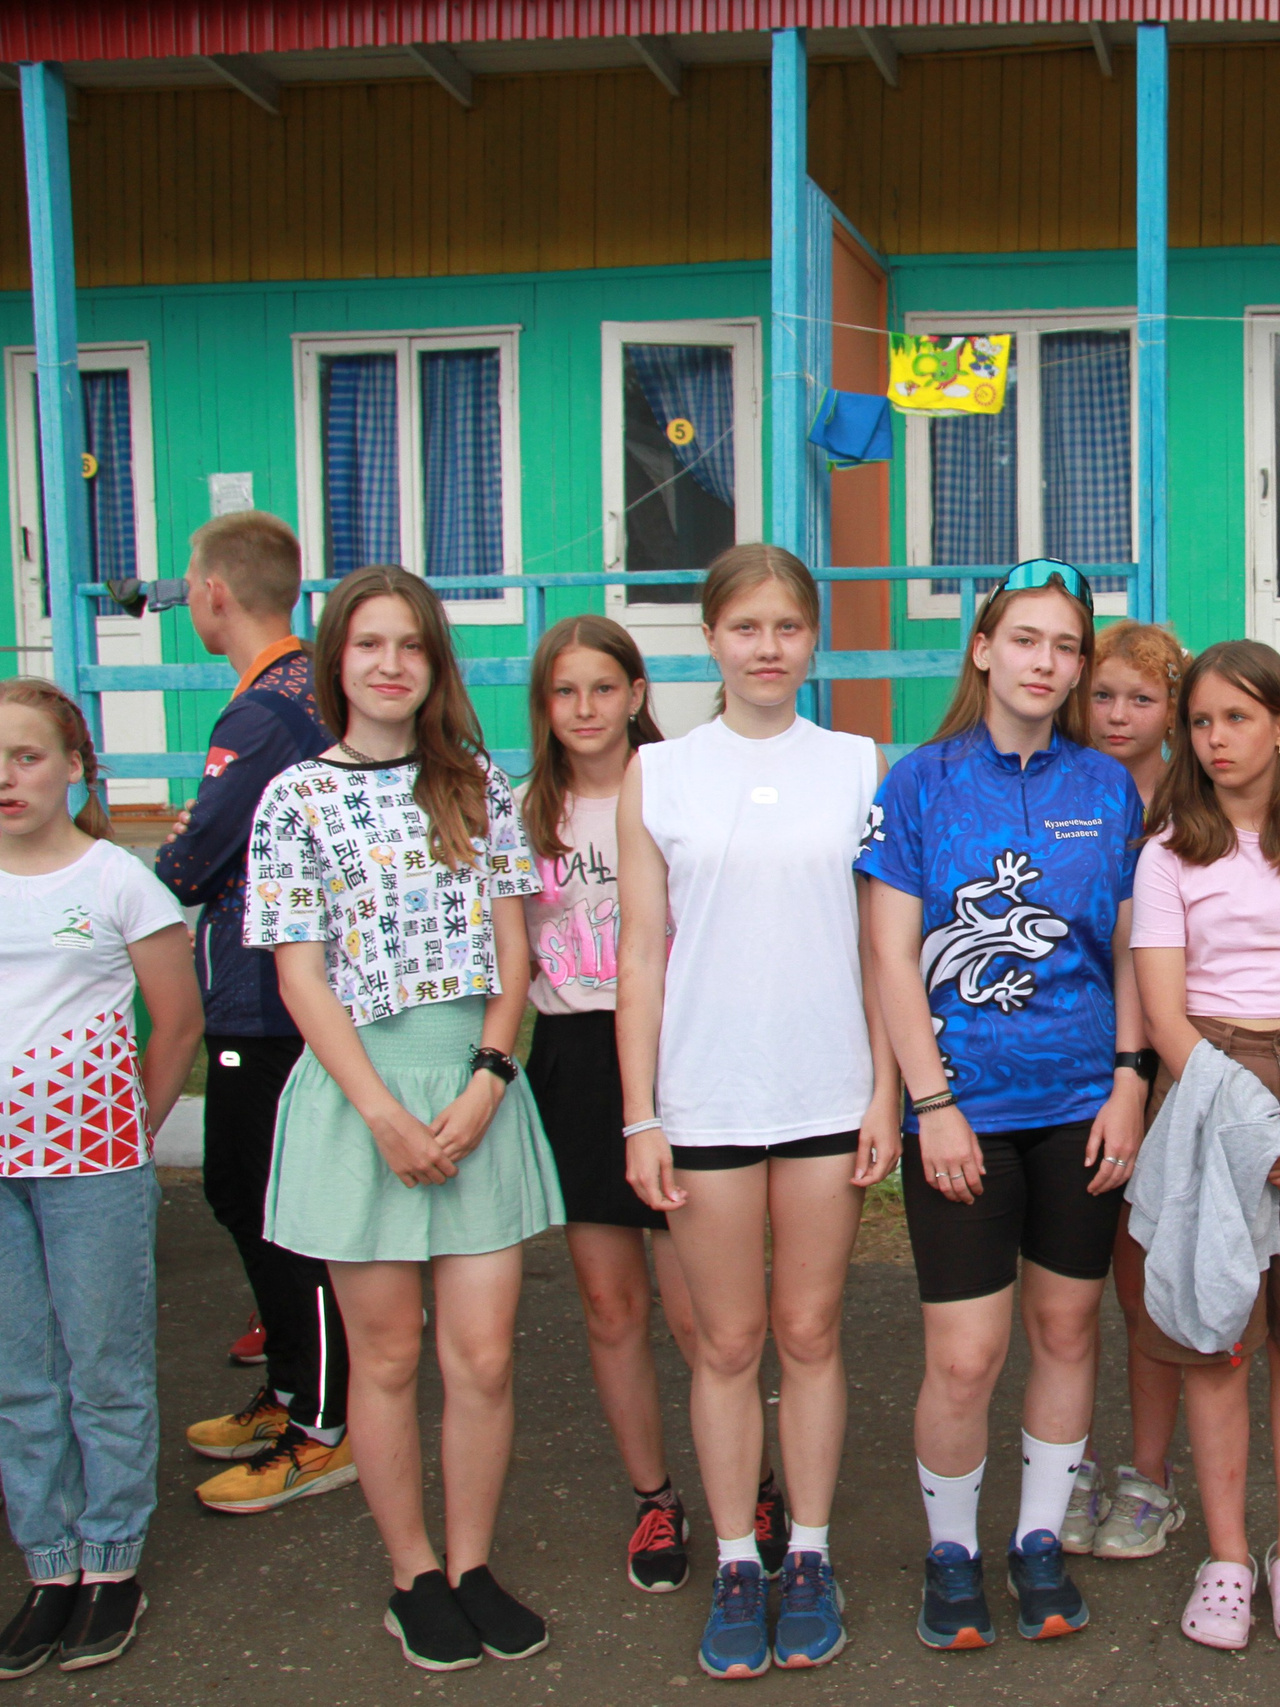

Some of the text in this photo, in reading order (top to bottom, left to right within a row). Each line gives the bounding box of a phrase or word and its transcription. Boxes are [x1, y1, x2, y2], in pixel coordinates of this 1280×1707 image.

[675, 424, 686, 439] 5
[320, 804, 346, 836] 武道
[344, 790, 377, 831] 未来
[1044, 818, 1103, 829] Кузнеченкова
[251, 819, 273, 862] 未来
[365, 828, 404, 845] 武道
[1055, 830, 1098, 840] Елизавета
[259, 863, 294, 880] 武道
[332, 839, 369, 891] 武道
[436, 867, 473, 889] 勝者
[380, 873, 400, 908] 勝者
[497, 878, 532, 895] 勝者
[261, 910, 280, 943] 勝者
[402, 916, 439, 938] 書道
[441, 891, 468, 939] 未来
[378, 911, 401, 960] 未来
[416, 976, 460, 1002] 発見
